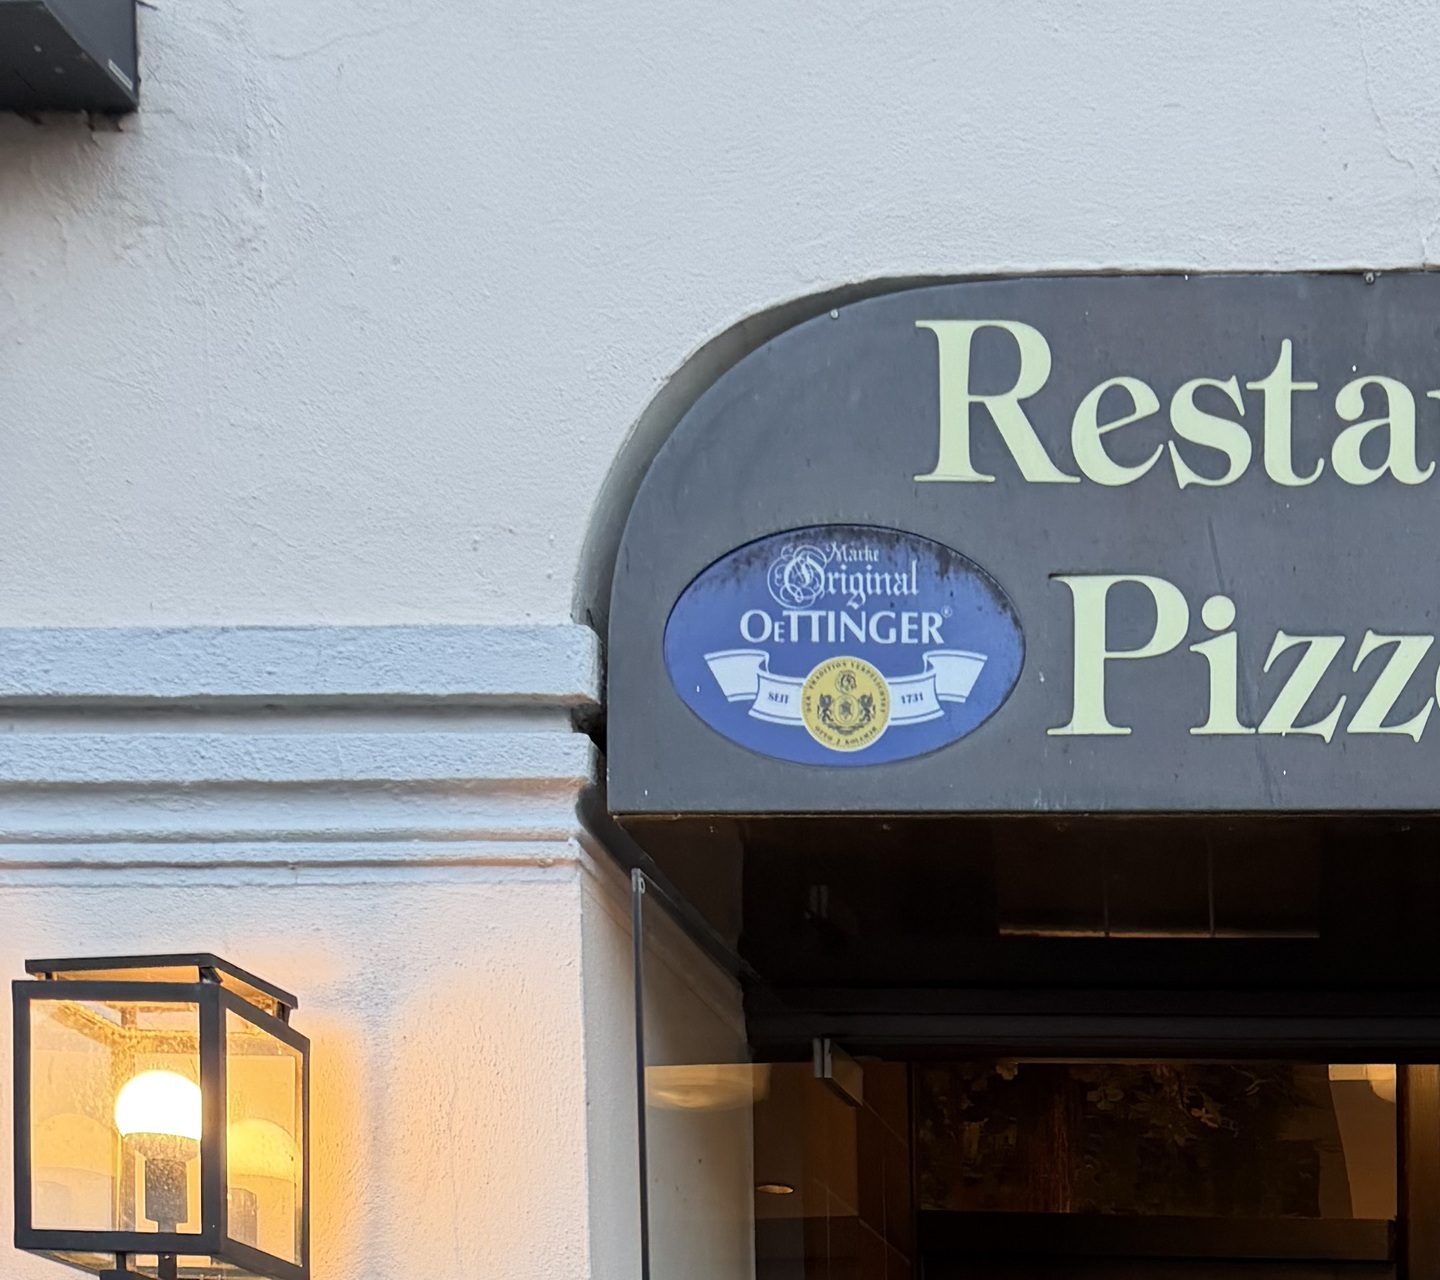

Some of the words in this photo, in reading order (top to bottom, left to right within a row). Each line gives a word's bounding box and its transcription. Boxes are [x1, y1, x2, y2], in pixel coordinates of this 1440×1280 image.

[826, 541, 880, 563] Marke
[767, 543, 919, 610] Original
[768, 692, 789, 704] SEIT
[900, 692, 924, 704] 1731
